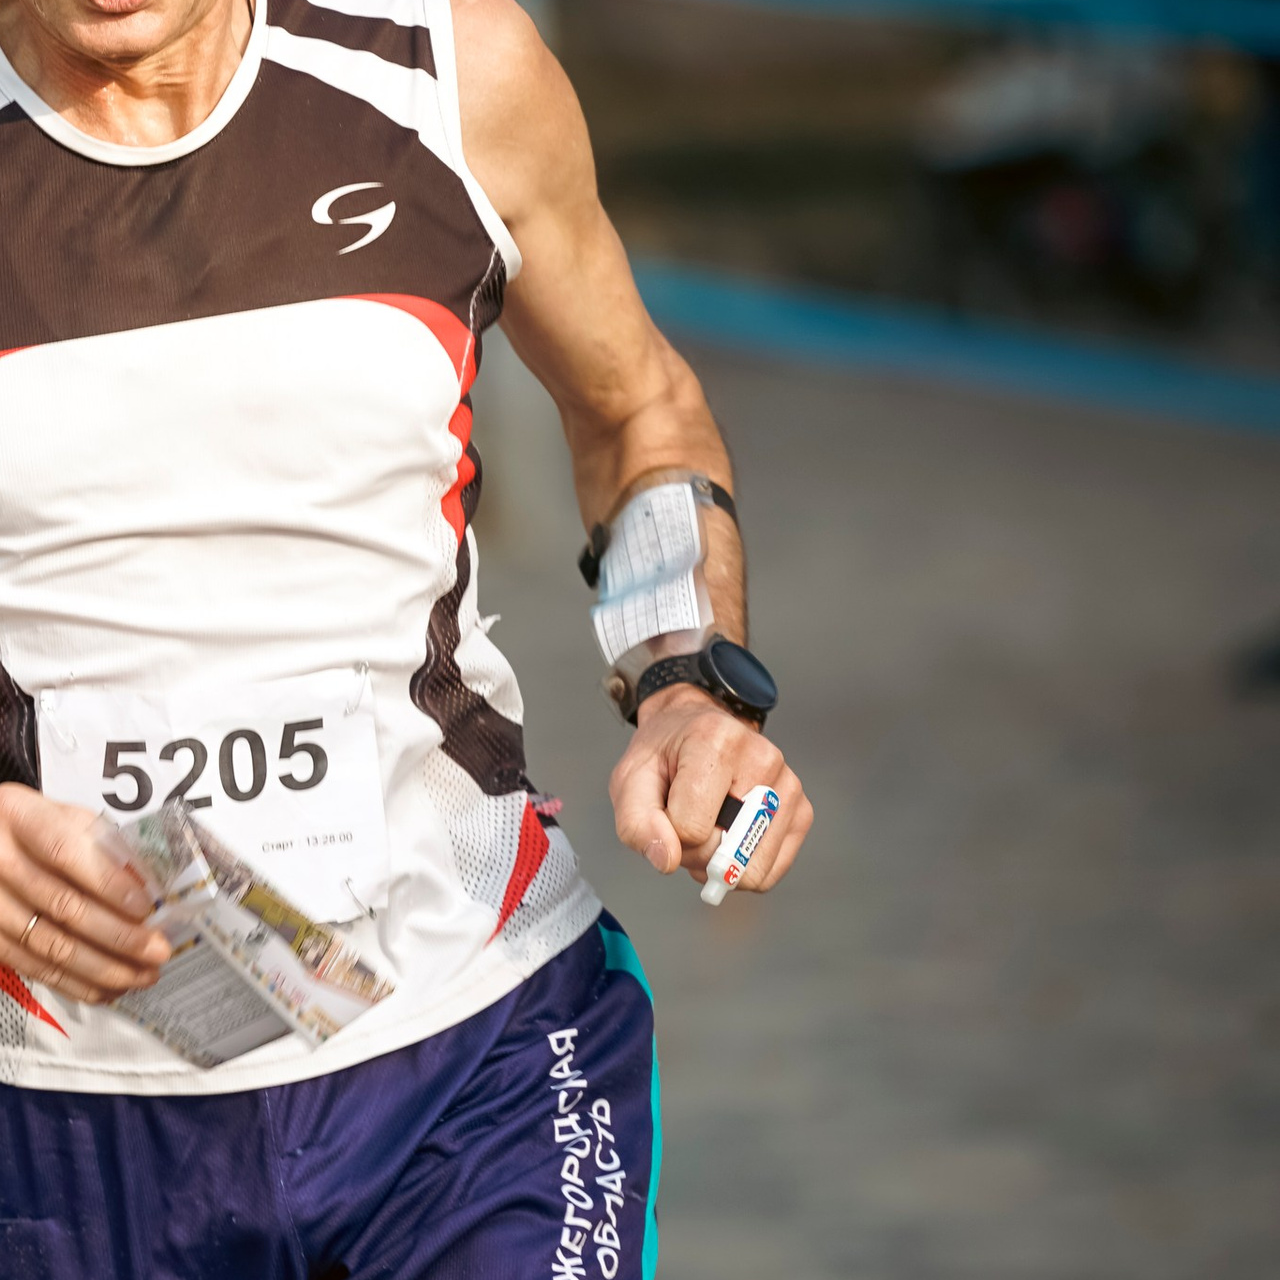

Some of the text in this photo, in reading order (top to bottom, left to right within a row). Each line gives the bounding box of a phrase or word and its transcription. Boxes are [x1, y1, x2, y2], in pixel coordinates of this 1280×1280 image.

[102, 717, 329, 811] 5205
[261, 840, 294, 854] Старт
[587, 1098, 626, 1280] ОБЛАСТЬ
